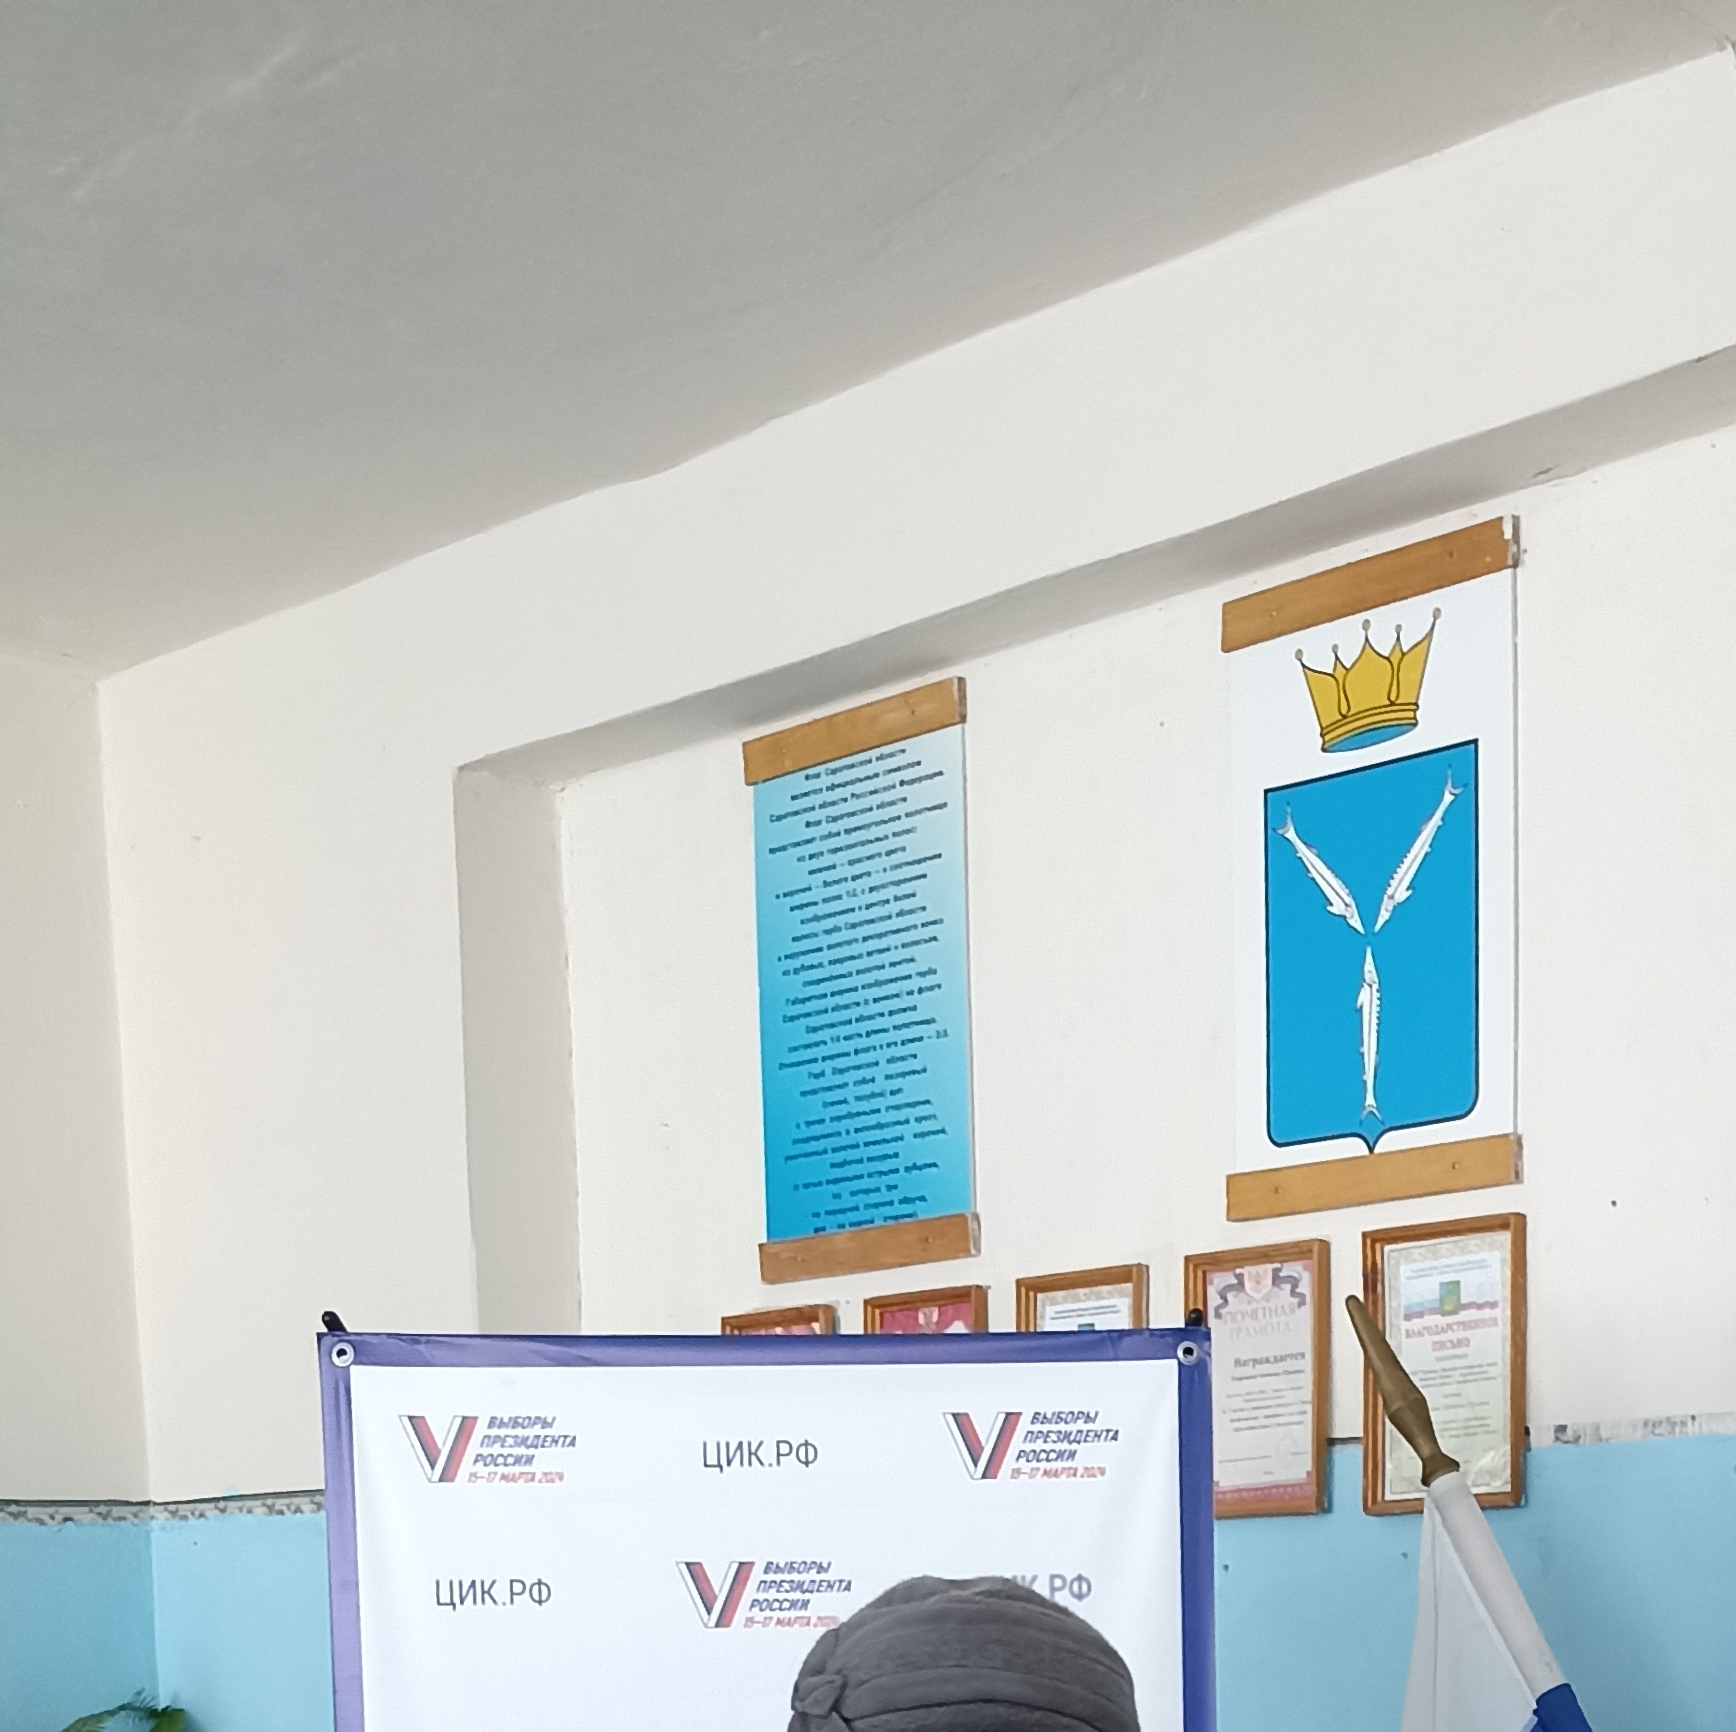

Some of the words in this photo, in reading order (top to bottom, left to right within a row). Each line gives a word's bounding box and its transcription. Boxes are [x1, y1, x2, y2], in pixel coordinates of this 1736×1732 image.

[487, 1416, 556, 1430] ВЫБОРЫ
[1030, 1411, 1099, 1425] ВЫБОРЫ
[480, 1435, 577, 1449] ПРЕЗИДЕНТА
[1022, 1429, 1119, 1444] ПРЕЗИДЕНТА
[473, 1453, 535, 1467] РОССИИ
[703, 1439, 818, 1473] ЦИК.РФ
[1016, 1449, 1078, 1463] РОССИИ
[763, 1561, 832, 1575] ВЫБОРЫ
[756, 1579, 852, 1594] ПРЕЗИДЕНТА
[436, 1578, 551, 1611] ЦИК.РФ
[749, 1599, 811, 1612] РОССИИ
